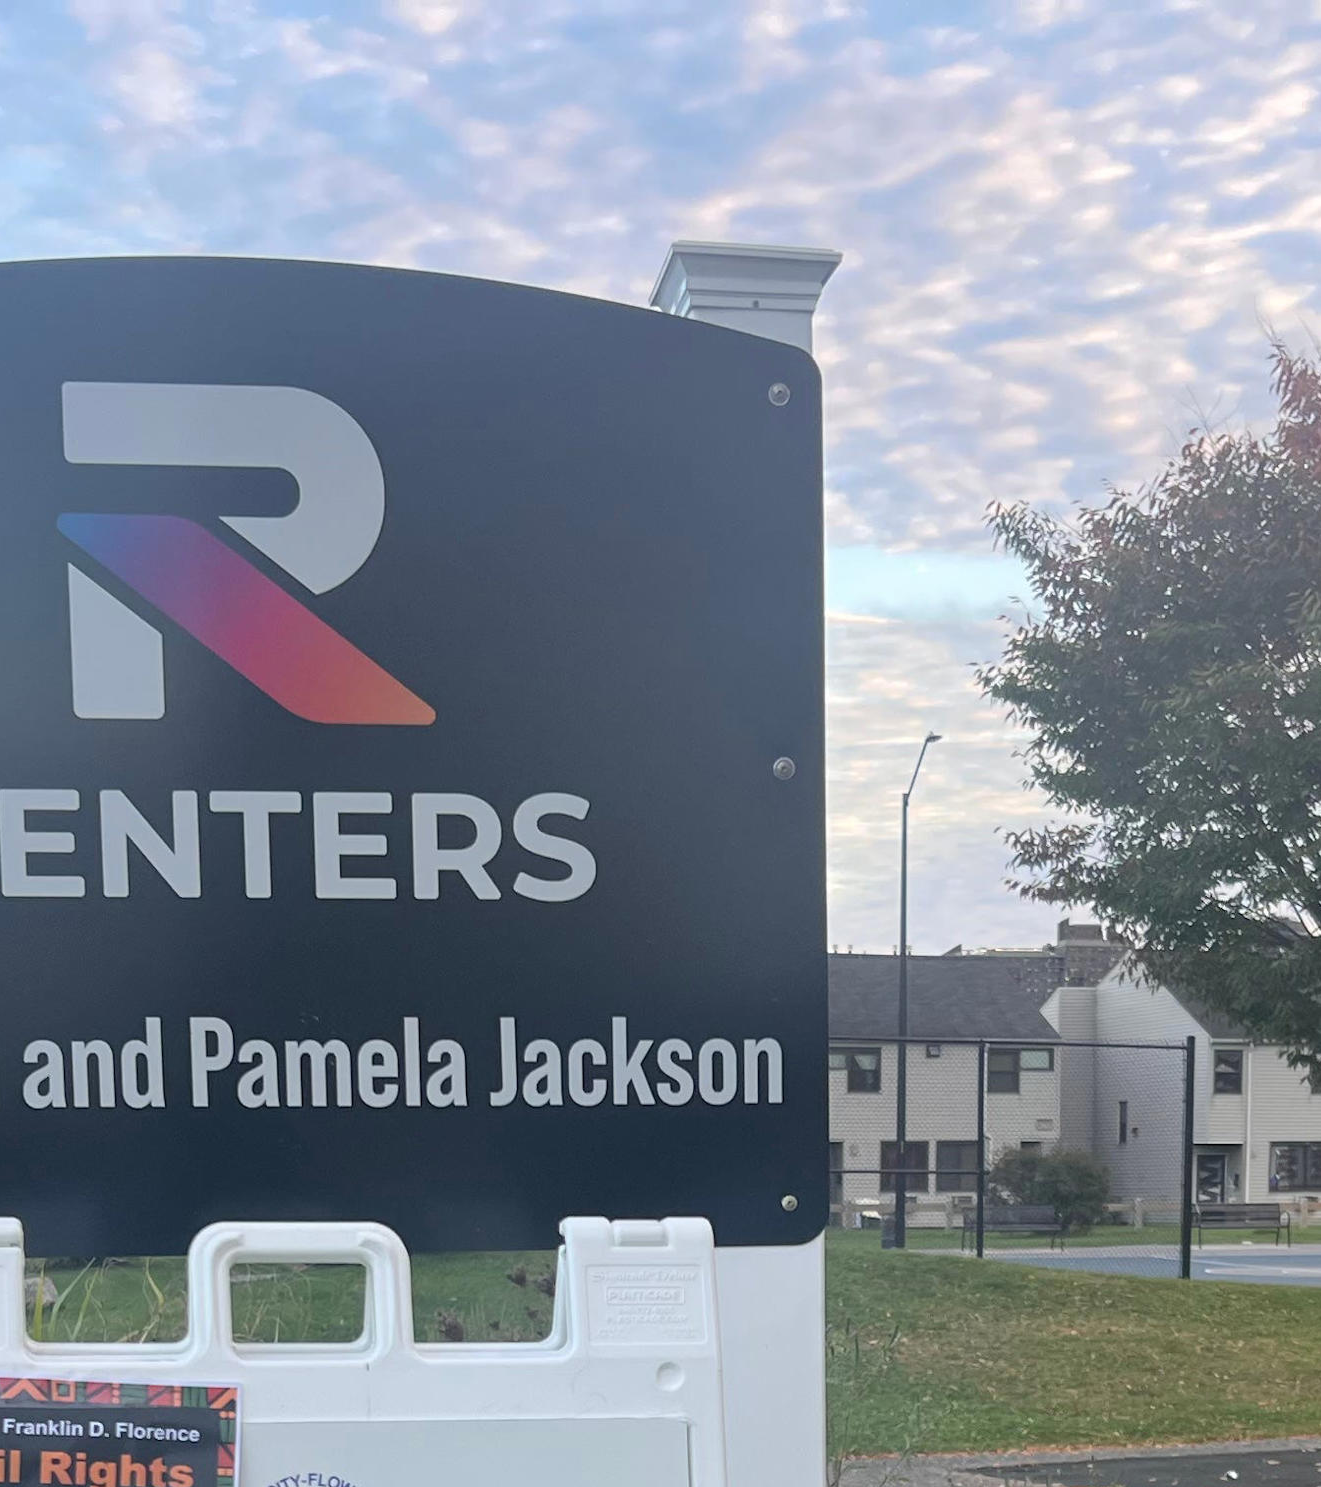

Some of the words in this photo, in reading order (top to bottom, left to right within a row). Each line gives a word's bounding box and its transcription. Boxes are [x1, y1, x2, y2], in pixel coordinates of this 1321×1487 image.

[55, 380, 437, 726] R
[23, 1016, 165, 1111] and
[190, 1016, 469, 1110] Pamela
[488, 1016, 785, 1109] Jackson
[2, 1417, 84, 1439] Franklin
[89, 1420, 110, 1439] D.
[115, 1421, 201, 1443] Florence
